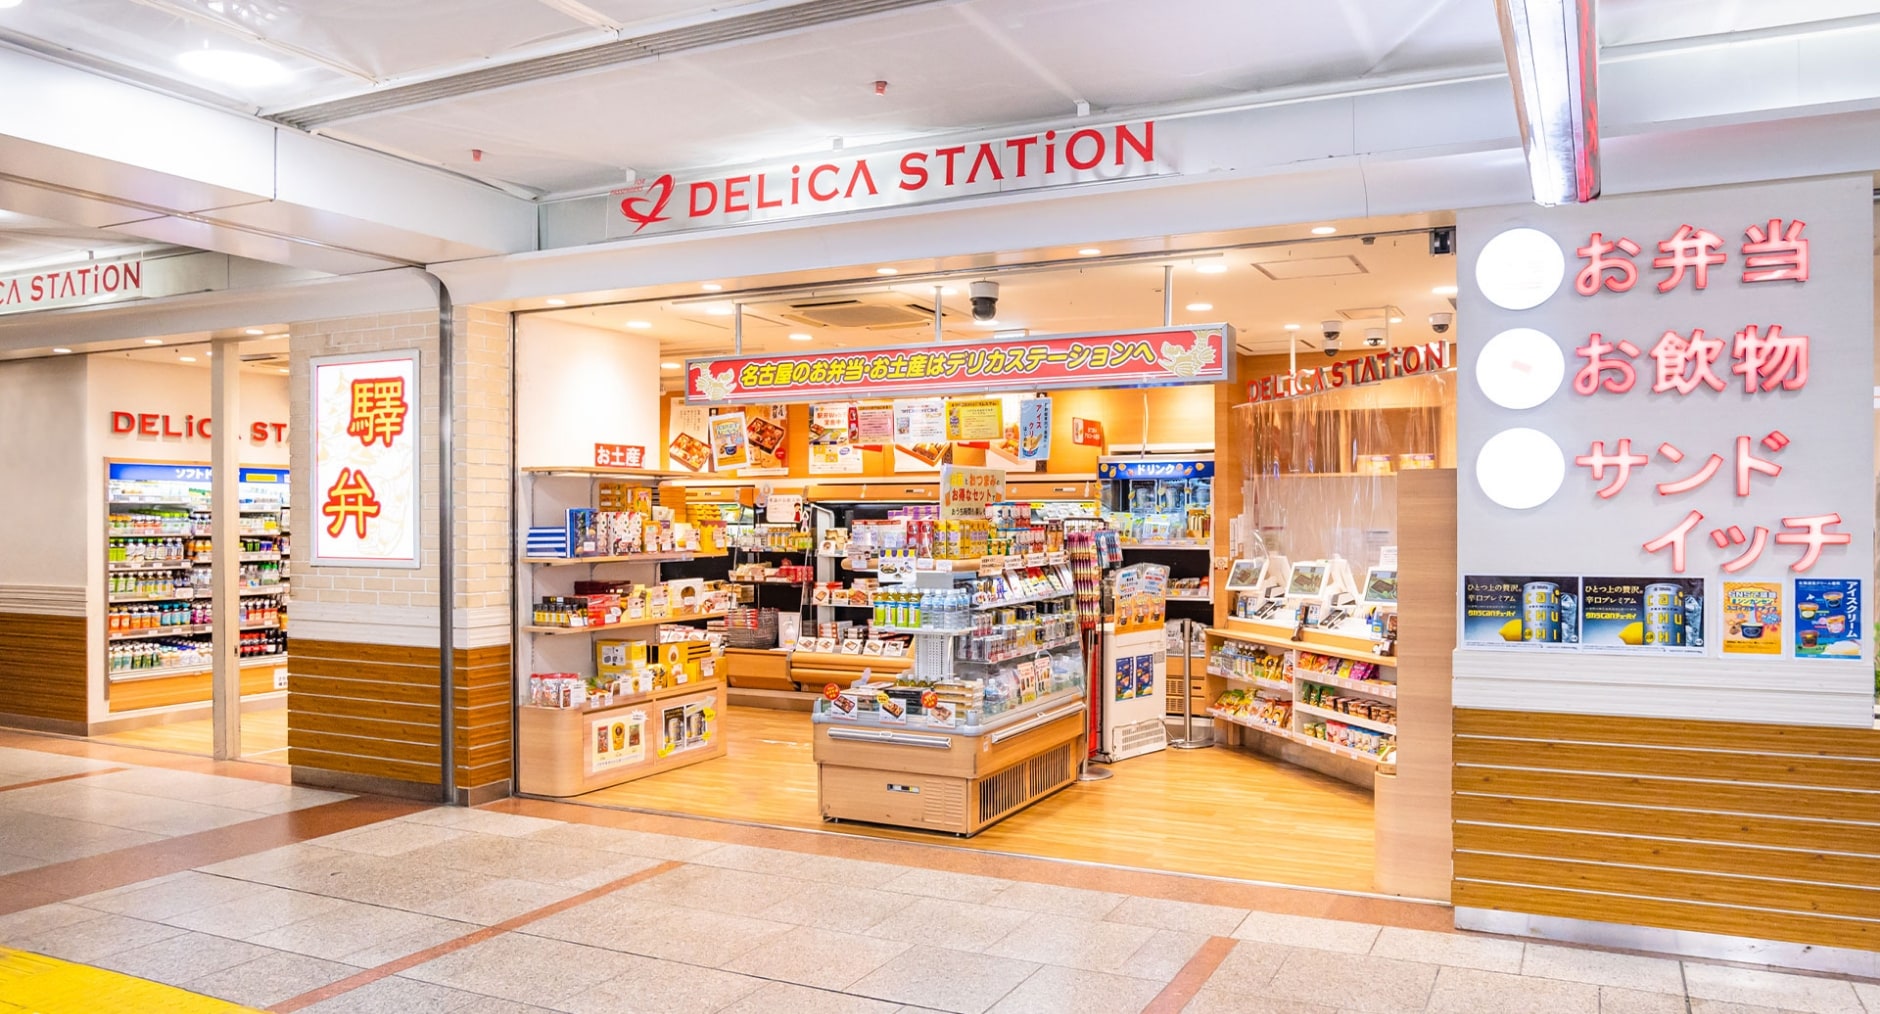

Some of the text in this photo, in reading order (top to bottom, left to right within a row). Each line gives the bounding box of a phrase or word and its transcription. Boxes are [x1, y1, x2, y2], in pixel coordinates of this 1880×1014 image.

[1574, 218, 1809, 296] お弁当
[741, 342, 1155, 388] 名古屋のお弁当・お土産はデリカステーションへ
[1573, 325, 1809, 396] お飲物
[112, 411, 213, 439] DELiC
[597, 445, 641, 467] お土産
[1137, 464, 1175, 476] ドリンク
[1575, 430, 1791, 499] サンド
[1642, 510, 1851, 573] イッチ
[1846, 581, 1858, 638] アイスクリーム
